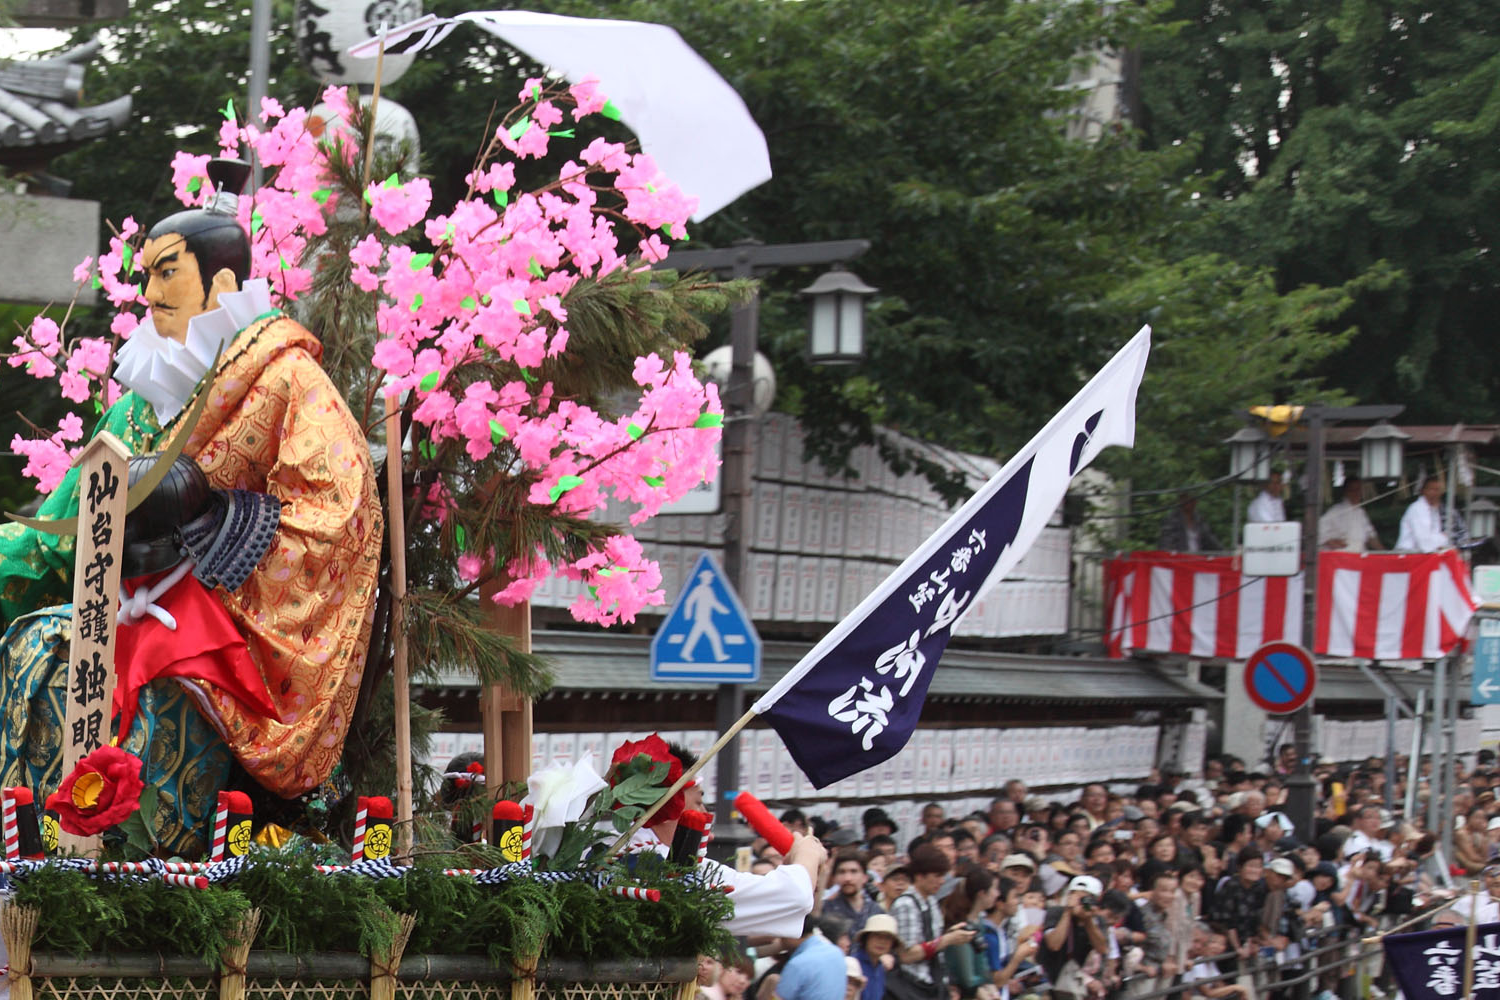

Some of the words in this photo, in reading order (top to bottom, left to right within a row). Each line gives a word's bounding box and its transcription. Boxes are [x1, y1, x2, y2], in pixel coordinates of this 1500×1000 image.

[71, 461, 119, 769] 仙台守護独眼
